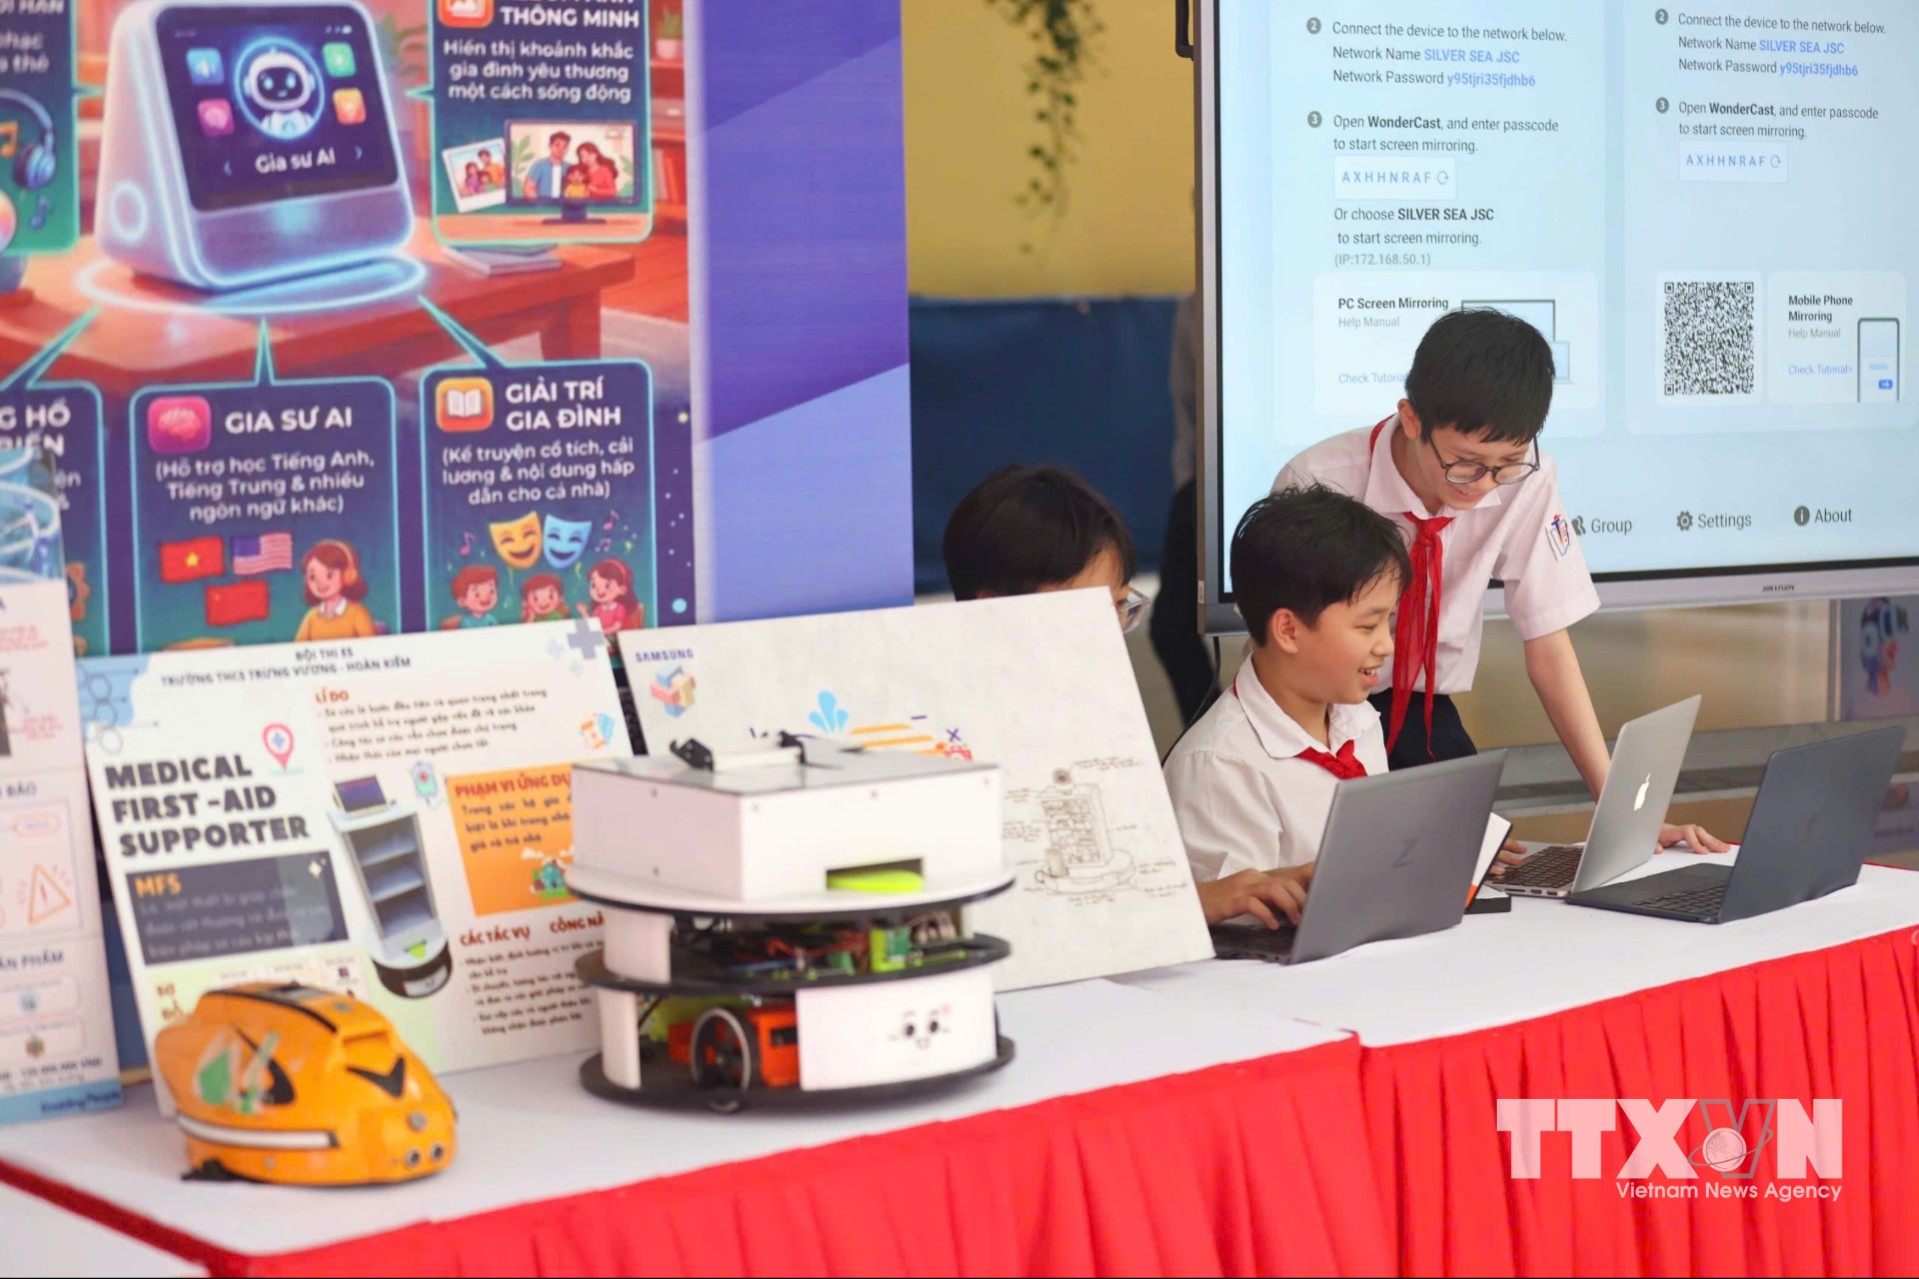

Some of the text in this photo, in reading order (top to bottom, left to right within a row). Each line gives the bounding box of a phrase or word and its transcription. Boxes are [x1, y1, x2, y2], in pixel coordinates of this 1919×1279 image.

[500, 3, 639, 28] THÔNG MINH
[1679, 13, 1886, 34] Connect the device to the network below.
[1333, 22, 1567, 41] Connect the device to the network below.
[1679, 37, 1844, 54] Network Name SILVER SEA JSC
[1333, 47, 1520, 63] Network Name SILVER SEA JSC
[450, 63, 478, 81] gia
[528, 63, 561, 82] yêu
[1679, 59, 1858, 77] Network Password y95tjri35fjdhb6
[1333, 70, 1383, 83] Network
[1386, 71, 1444, 85] Password
[448, 82, 632, 104] một cách sống động
[1679, 102, 1879, 120] Open WonderCast, and enter passcode
[1334, 115, 1559, 133] Open WonderCast, and enter passcode
[1679, 123, 1807, 140] to start screen mirroring.
[1334, 139, 1478, 154] to start screen mirroring.
[255, 151, 287, 174] Gia
[317, 148, 336, 166] AI
[1335, 208, 1494, 221] Or choose SILVER SEA JSC
[1338, 231, 1482, 247] to start screen mirroring.
[1334, 253, 1431, 267] (IP:172.168.50.1)
[1338, 297, 1449, 311] PC Screen Mirroring
[1789, 295, 1853, 306] Mobile Phone
[1338, 317, 1400, 329] Help Manual
[1789, 311, 1832, 324] Mirroring
[1789, 328, 1841, 338] Help Manual
[1339, 373, 1368, 384] Check
[1789, 364, 1814, 375] Check
[505, 375, 605, 404] GIẢI TRÍ
[224, 405, 353, 434] GIA SƯ AI
[506, 404, 622, 431] GIA ĐÌNH
[566, 440, 604, 456] tích,
[271, 453, 325, 474] Tiếng
[330, 449, 375, 468] Anh,
[500, 466, 513, 481] &
[550, 461, 596, 481] dung
[601, 456, 635, 477] hấp
[228, 477, 287, 499] Trung
[291, 477, 305, 492] &
[508, 484, 541, 503] cho
[571, 480, 611, 499] nhà)
[190, 499, 241, 525] ngôn
[290, 493, 344, 515] khác)
[1815, 508, 1852, 523] About
[1591, 517, 1632, 536] Group
[1698, 513, 1752, 530] Settings
[635, 648, 694, 663] SAMSUNG
[104, 753, 252, 790] MEDICAL
[500, 780, 515, 792] VI
[112, 793, 198, 823] FIRST
[119, 816, 310, 857] SUPPORTER
[134, 872, 182, 898] MFS
